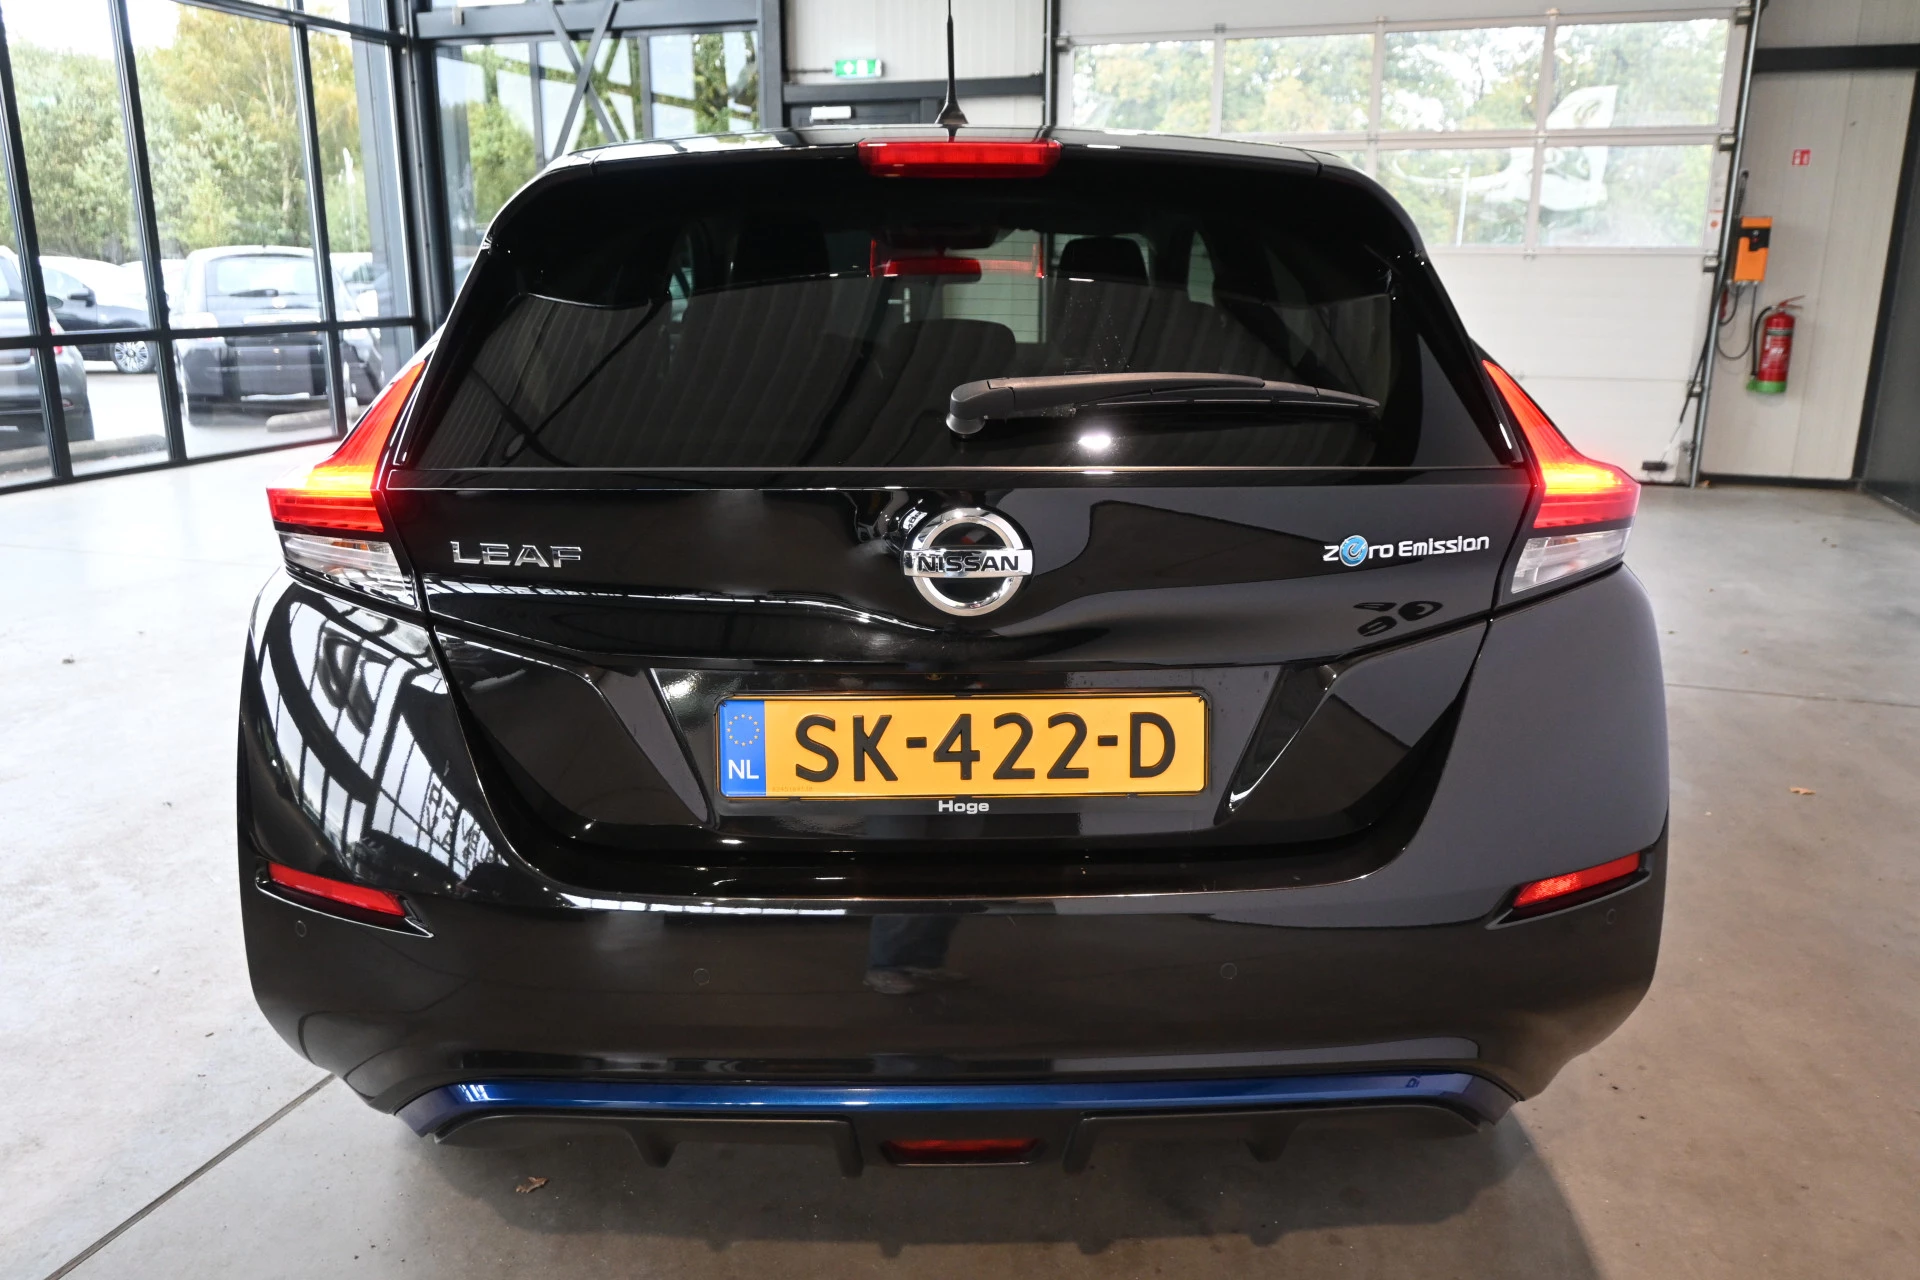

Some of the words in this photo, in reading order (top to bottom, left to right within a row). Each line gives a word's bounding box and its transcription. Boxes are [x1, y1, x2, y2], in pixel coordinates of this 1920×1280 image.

[450, 541, 582, 568] LEAF
[1398, 535, 1490, 557] Emission
[917, 555, 1019, 572] NISSAN
[795, 712, 1176, 783] SK-422-D
[728, 759, 759, 780] NL
[938, 800, 990, 814] Hoge
